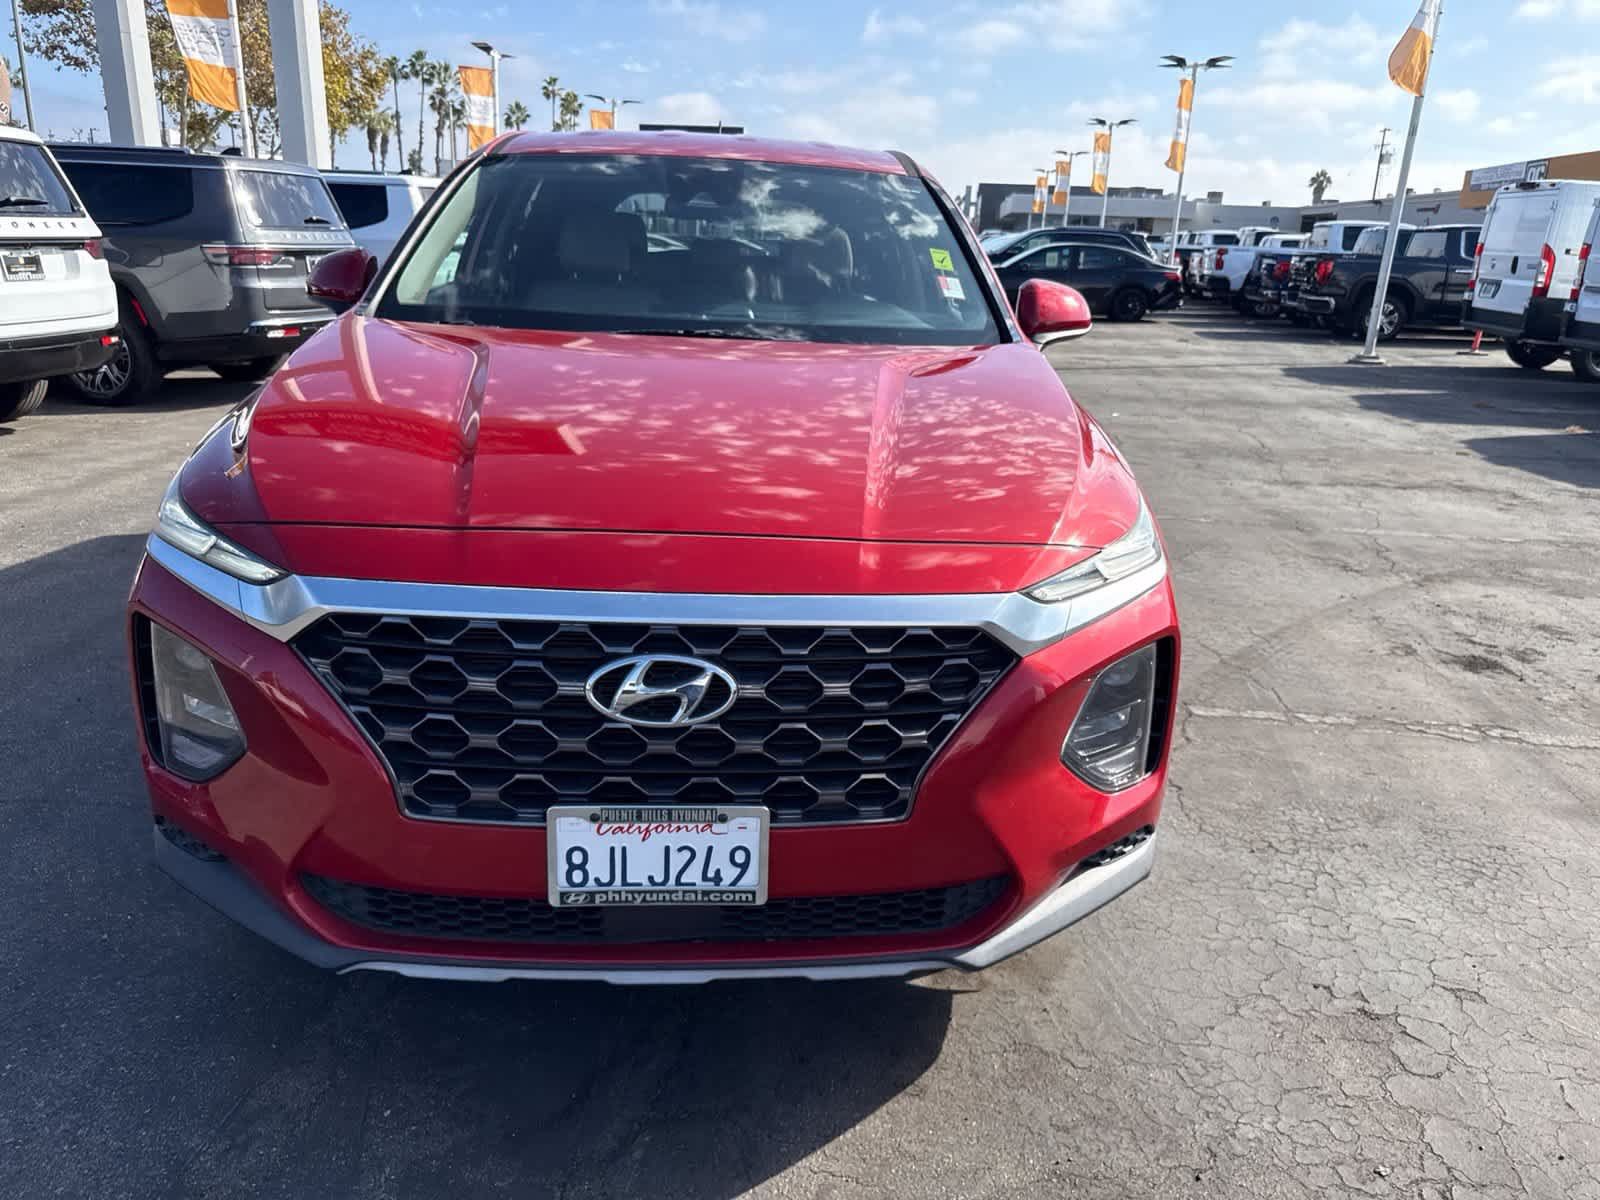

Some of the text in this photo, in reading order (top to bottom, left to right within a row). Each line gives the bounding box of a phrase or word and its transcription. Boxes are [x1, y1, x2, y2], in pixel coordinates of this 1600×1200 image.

[0, 221, 77, 229] ONEER
[602, 809, 718, 822] PUENTE HILLS HYUNDAI
[565, 845, 751, 888] 8JLJ249
[594, 891, 753, 904] phhyundai.com
